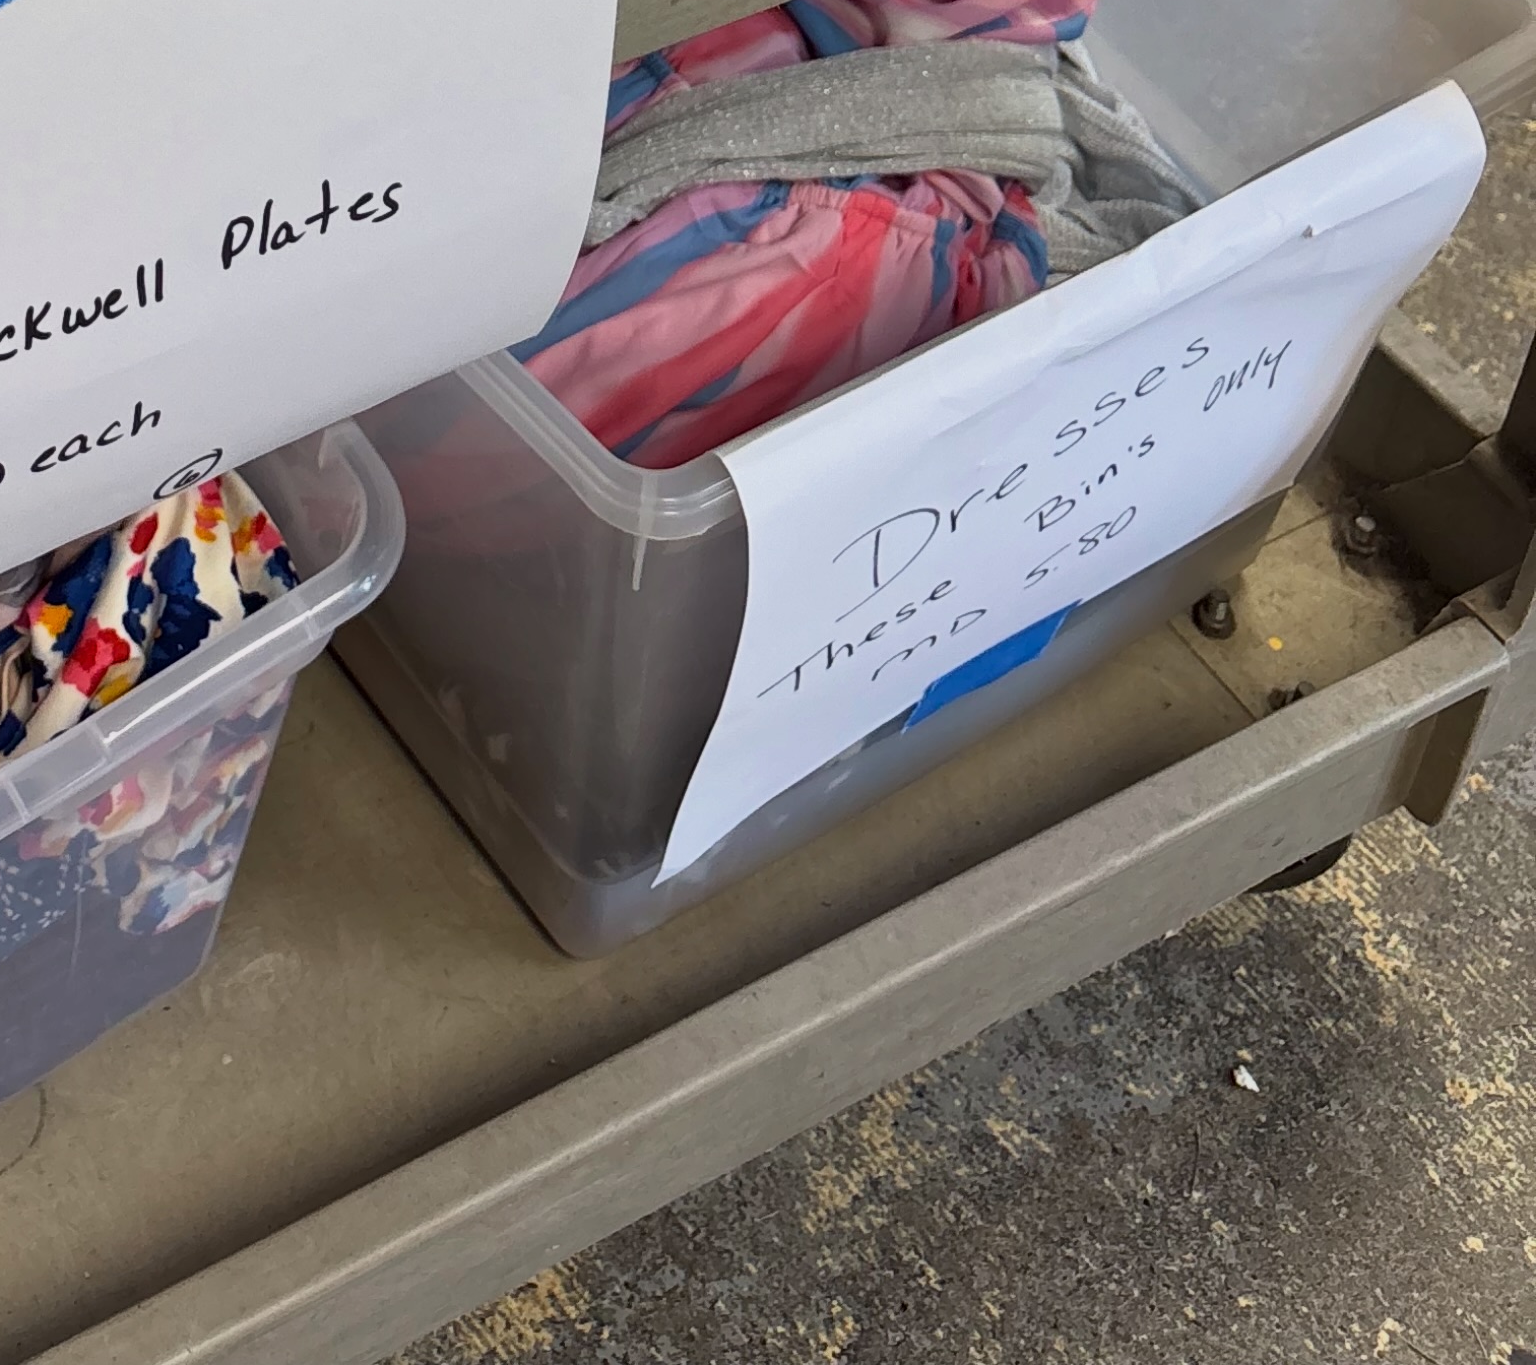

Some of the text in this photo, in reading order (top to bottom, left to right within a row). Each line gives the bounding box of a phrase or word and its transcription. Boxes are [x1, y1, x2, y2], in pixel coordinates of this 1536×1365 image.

[29, 400, 163, 474] each
[756, 339, 1294, 699] These Bin's only
[832, 336, 1212, 623] Dresses
